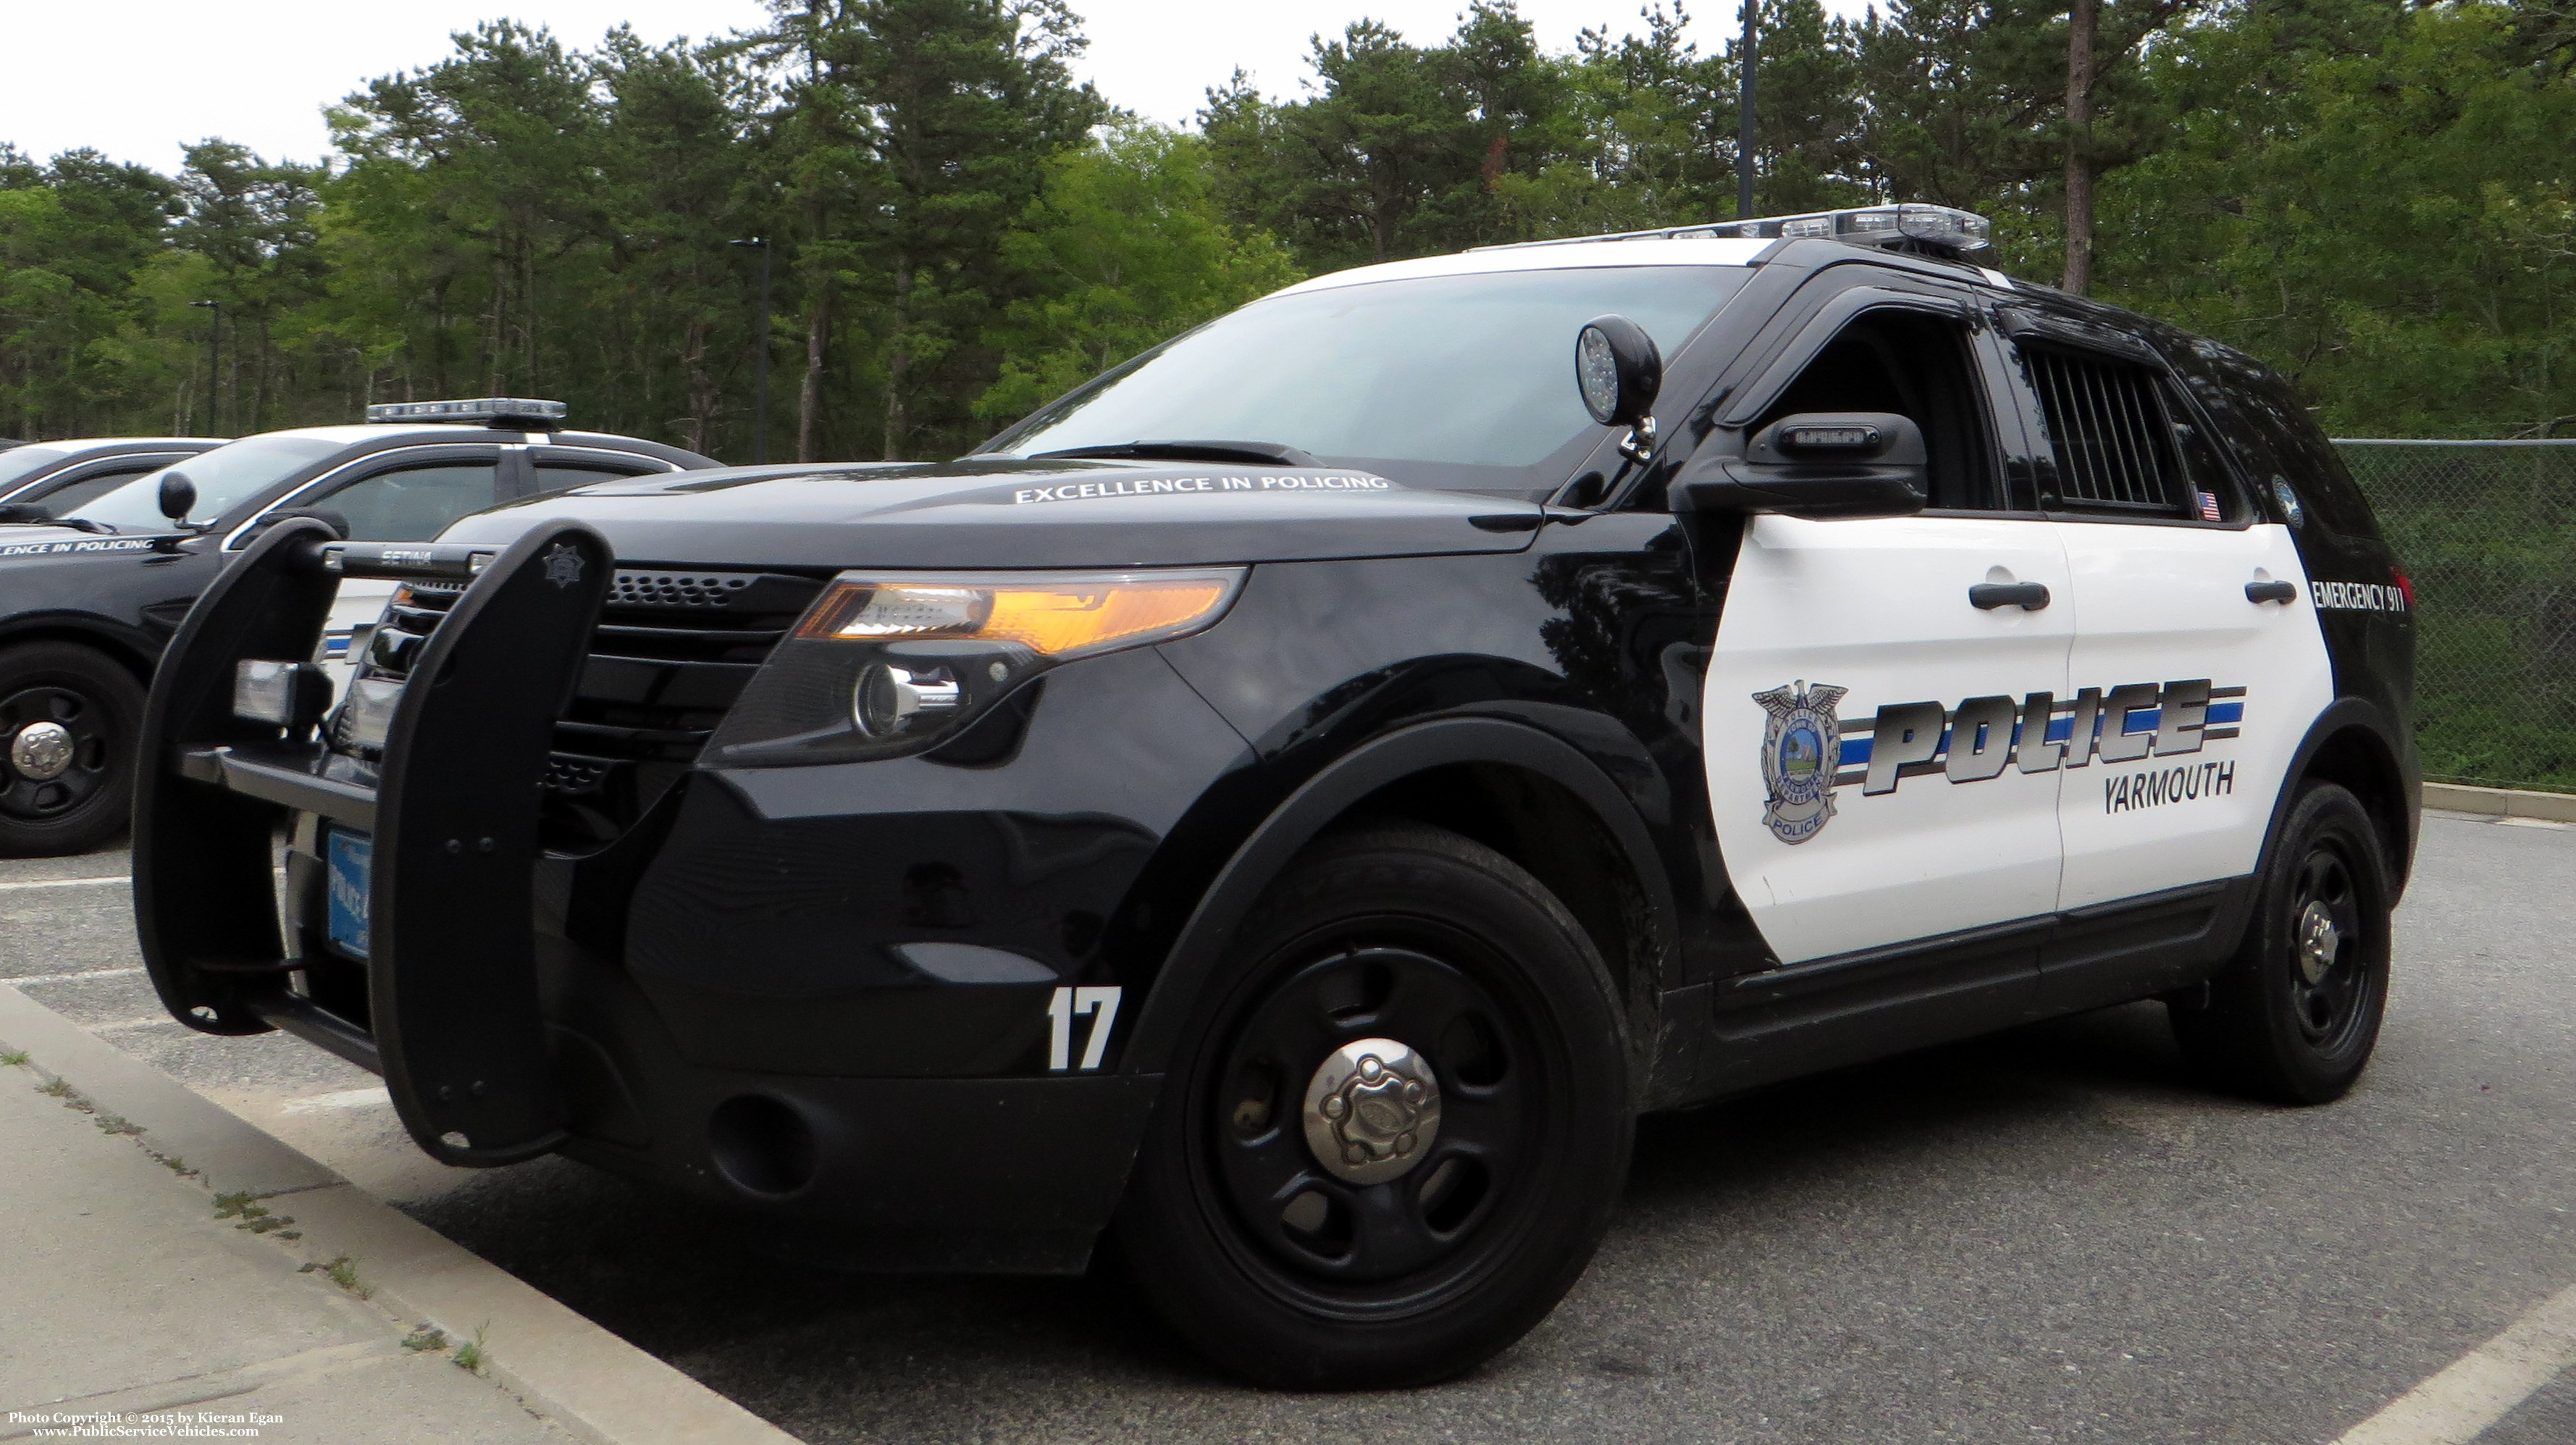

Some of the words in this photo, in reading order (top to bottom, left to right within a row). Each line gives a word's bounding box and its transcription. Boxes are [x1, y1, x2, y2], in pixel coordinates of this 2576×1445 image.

[1015, 477, 1212, 504] EXCELLENCE
[1222, 476, 1252, 490] IN
[1261, 475, 1389, 490] POLICING
[0, 544, 51, 556] ENCE
[51, 543, 72, 553] IN
[75, 539, 155, 552] POLICING
[2312, 581, 2385, 611] EMERGENCY
[2387, 585, 2405, 612] 911
[1863, 679, 2212, 797] POLICE
[2105, 761, 2235, 814] YARMOUTH
[1772, 813, 1824, 836] POLICE
[1049, 986, 1123, 1071] 17
